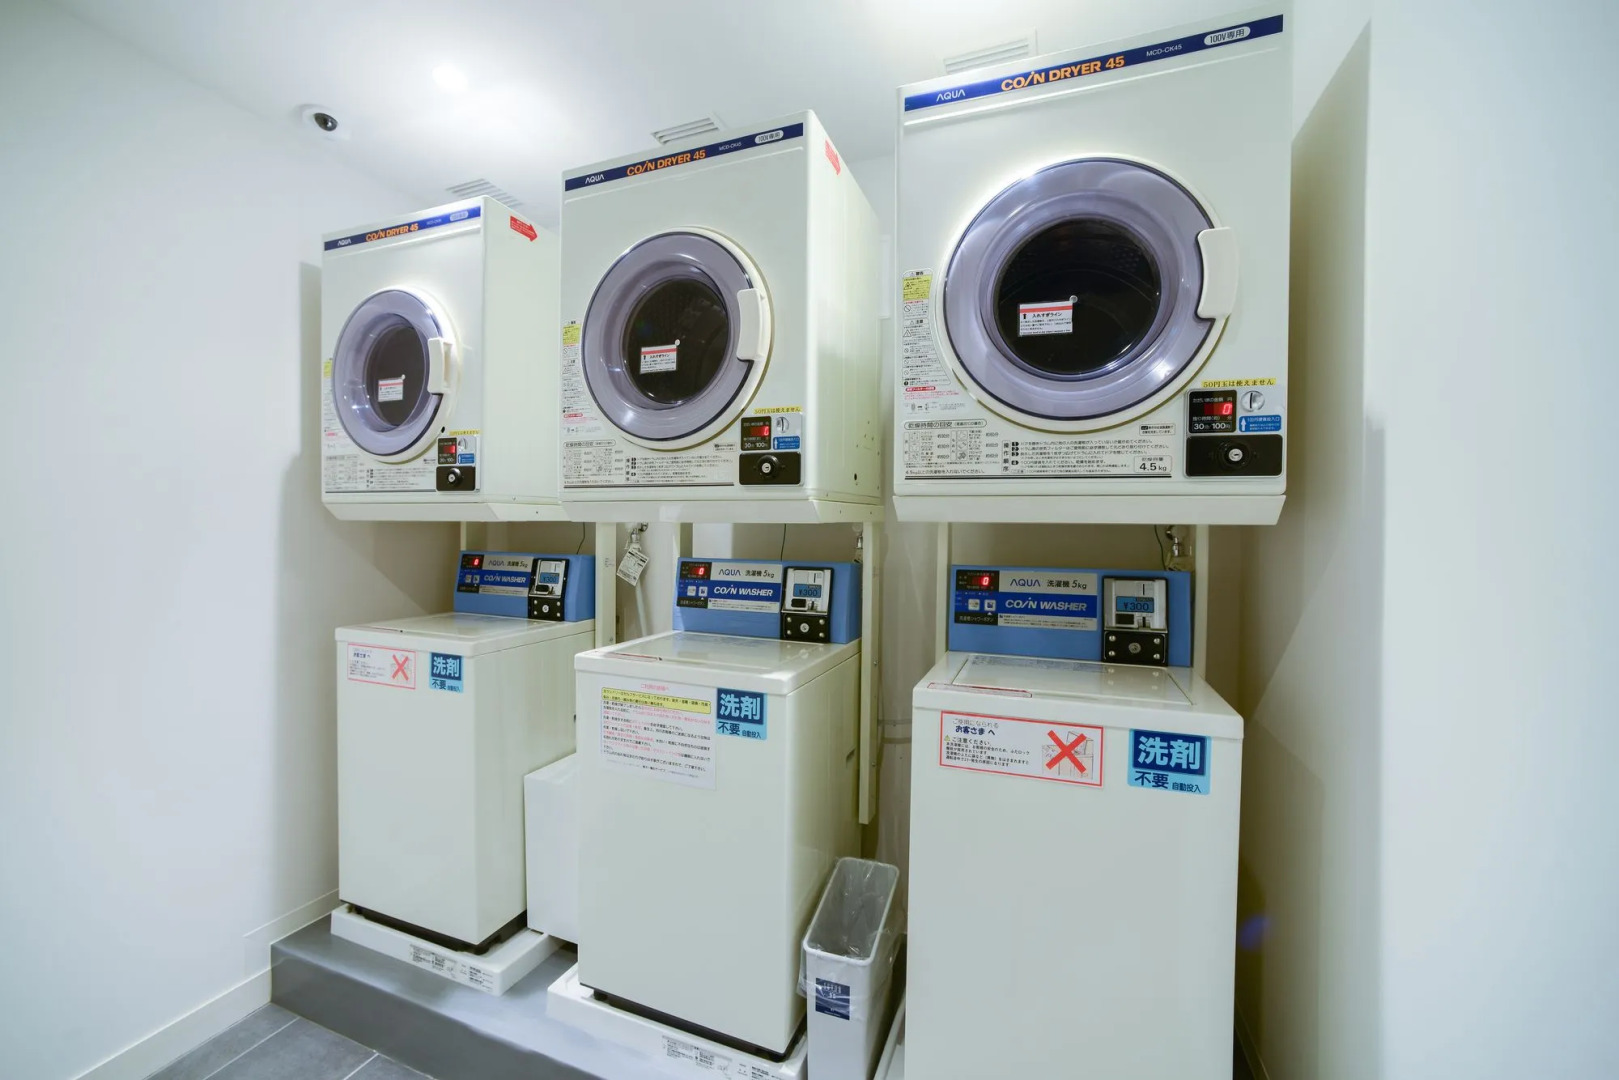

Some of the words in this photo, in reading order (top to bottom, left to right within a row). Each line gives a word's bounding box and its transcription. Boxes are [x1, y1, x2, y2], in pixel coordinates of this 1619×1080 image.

[1209, 28, 1245, 44] 100V専用
[1146, 43, 1183, 57] MCD-CK45
[1049, 61, 1101, 82] DRYER
[1105, 56, 1125, 70] 45
[936, 89, 966, 102] AQUA
[657, 152, 691, 169] DRYER
[693, 149, 706, 160] 45
[585, 174, 605, 184] AQUA
[387, 225, 409, 238] DRYER
[410, 222, 419, 232] 45
[1222, 404, 1232, 415] 0
[1139, 462, 1157, 471] 4.5
[699, 567, 705, 575] 0
[718, 568, 741, 577] AQUA
[763, 570, 775, 579] 5kg
[501, 576, 527, 584] WASHER
[981, 576, 989, 586] 0
[1009, 578, 1041, 588] AQUA
[1046, 579, 1070, 588] 洗濯機
[1071, 580, 1087, 590] 5kg
[738, 588, 774, 597] WASHER
[1040, 600, 1088, 612] WASHER
[1123, 602, 1150, 611] ¥300
[433, 656, 460, 678] 洗剤
[432, 678, 447, 690] 不要
[719, 692, 761, 720] 洗剤
[718, 720, 741, 736] 不要
[1138, 736, 1200, 770] 洗剤
[1134, 770, 1169, 789] 不要
[1172, 781, 1202, 793] 自動投入
